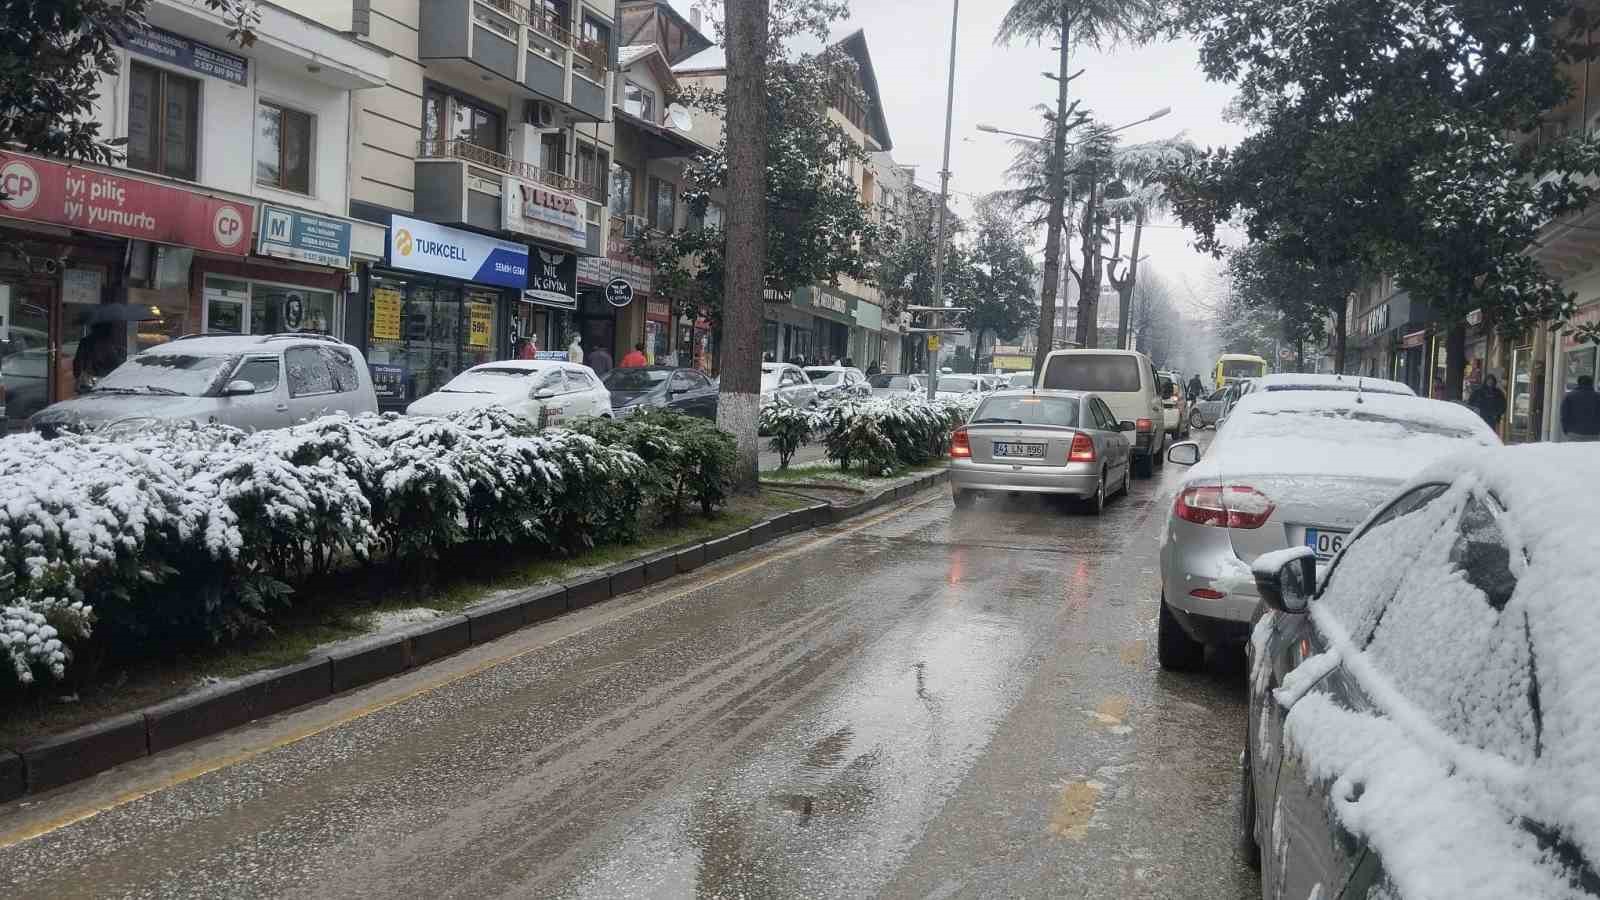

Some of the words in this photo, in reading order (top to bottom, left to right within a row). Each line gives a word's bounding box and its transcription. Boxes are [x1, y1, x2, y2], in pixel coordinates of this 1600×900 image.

[4, 173, 33, 197] CP
[65, 171, 86, 194] iyi
[90, 179, 126, 205] piliç
[64, 195, 84, 217] iyi
[88, 206, 155, 231] yumurta
[218, 216, 239, 236] CP
[271, 218, 286, 238] M
[415, 238, 468, 262] TURKCELL
[512, 265, 526, 276] GSM
[999, 444, 1008, 456] 41
[1318, 534, 1343, 553] 06
